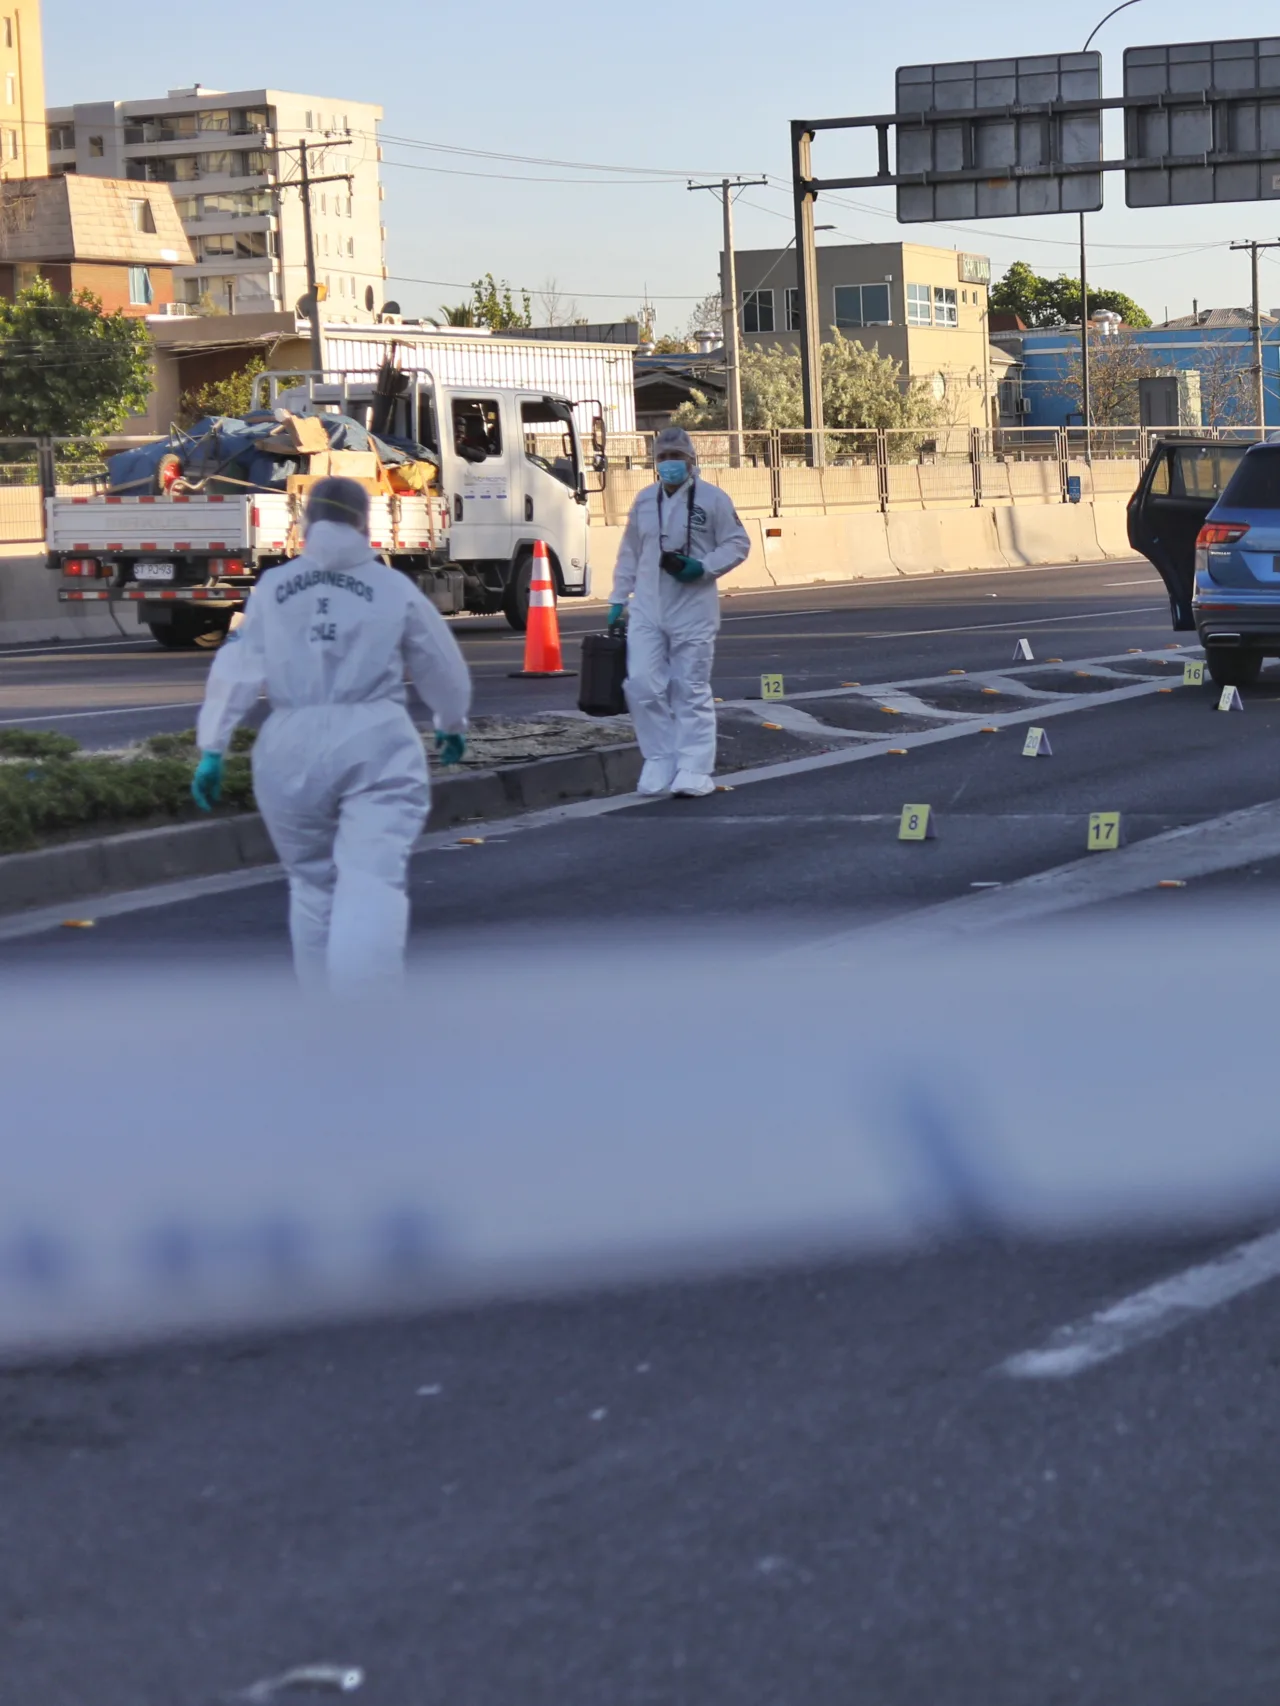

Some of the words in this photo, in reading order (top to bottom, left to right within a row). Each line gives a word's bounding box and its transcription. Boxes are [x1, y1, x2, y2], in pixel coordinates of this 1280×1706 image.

[275, 570, 374, 604] CARABINEROS
[1186, 668, 1201, 680] 16
[764, 681, 781, 693] 12
[908, 814, 918, 830] 8
[1092, 822, 1115, 840] 17
